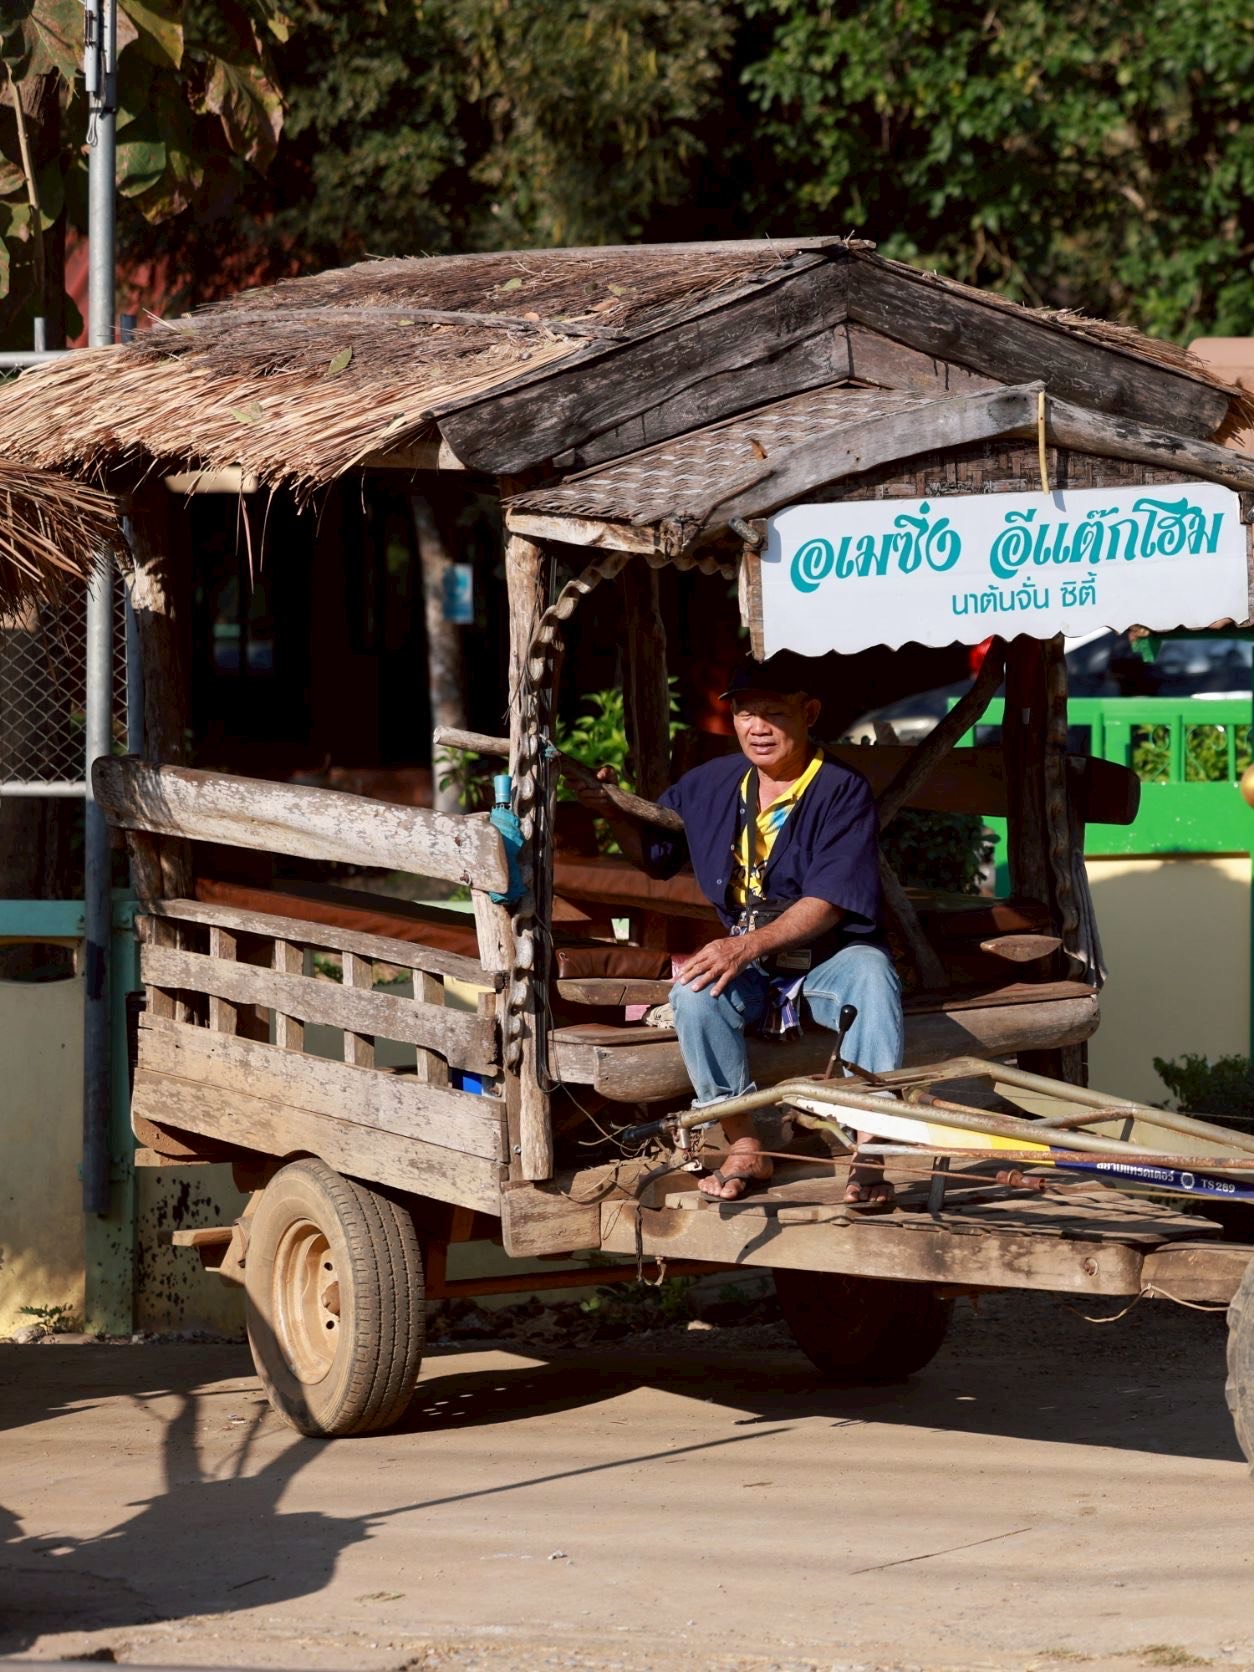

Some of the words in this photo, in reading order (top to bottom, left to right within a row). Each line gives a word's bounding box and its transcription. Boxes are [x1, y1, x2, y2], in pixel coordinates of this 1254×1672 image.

[789, 501, 962, 594] อเมซิ่ง
[989, 496, 1225, 580] อีแต๊กโฮม
[951, 576, 1050, 616] นาต้นจั่น
